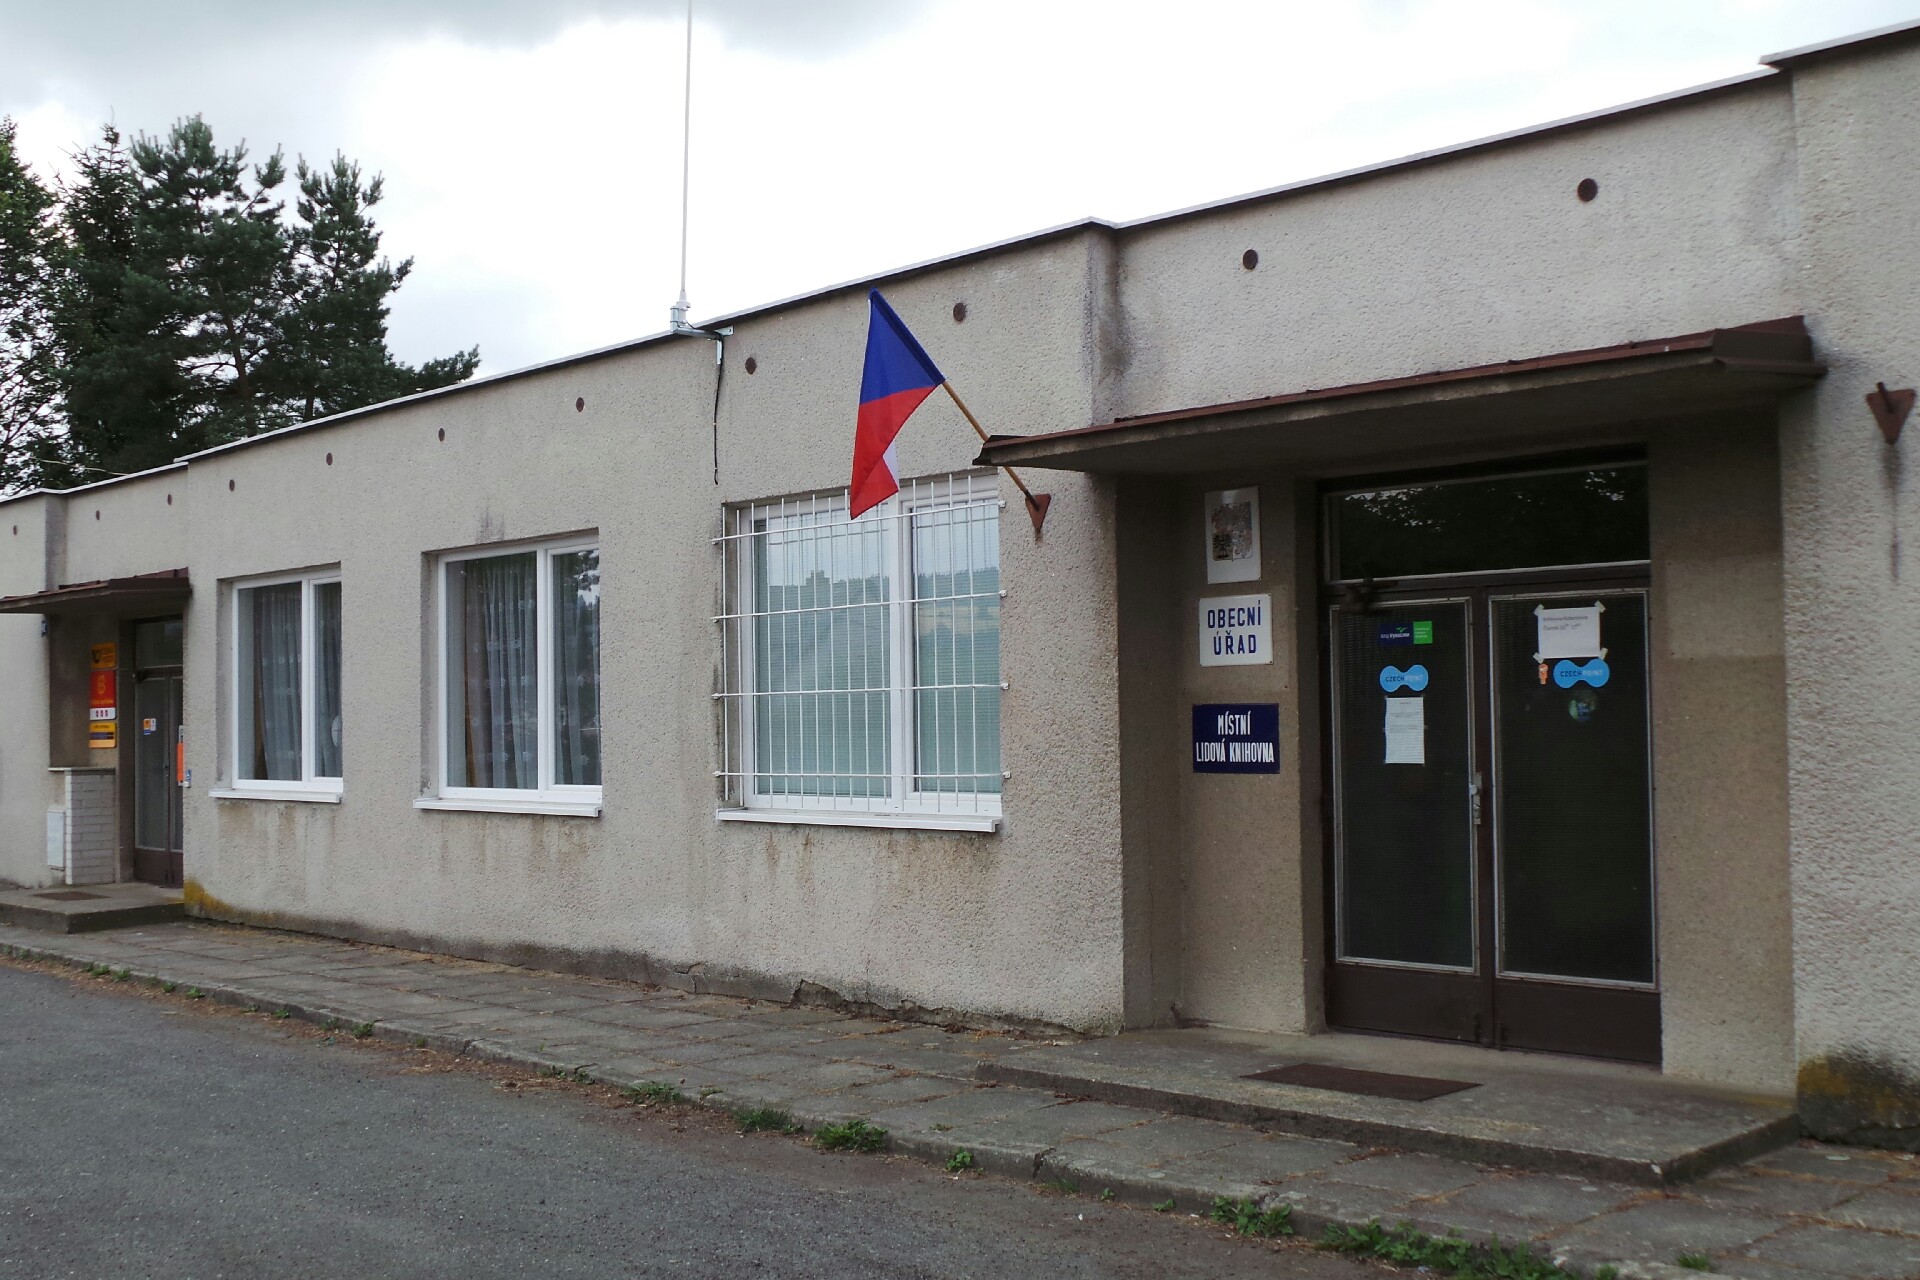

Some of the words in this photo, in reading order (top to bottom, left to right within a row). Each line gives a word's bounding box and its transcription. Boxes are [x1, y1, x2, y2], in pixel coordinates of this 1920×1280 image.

[1207, 599, 1261, 629] OBECNÍ
[1213, 629, 1257, 656] ÚŘAD
[1385, 675, 1405, 683] CZECH
[1217, 710, 1252, 736] MÍSTNÍ
[1195, 737, 1227, 763] LIDOVÁ
[1229, 742, 1275, 763] KNIHOVNA
